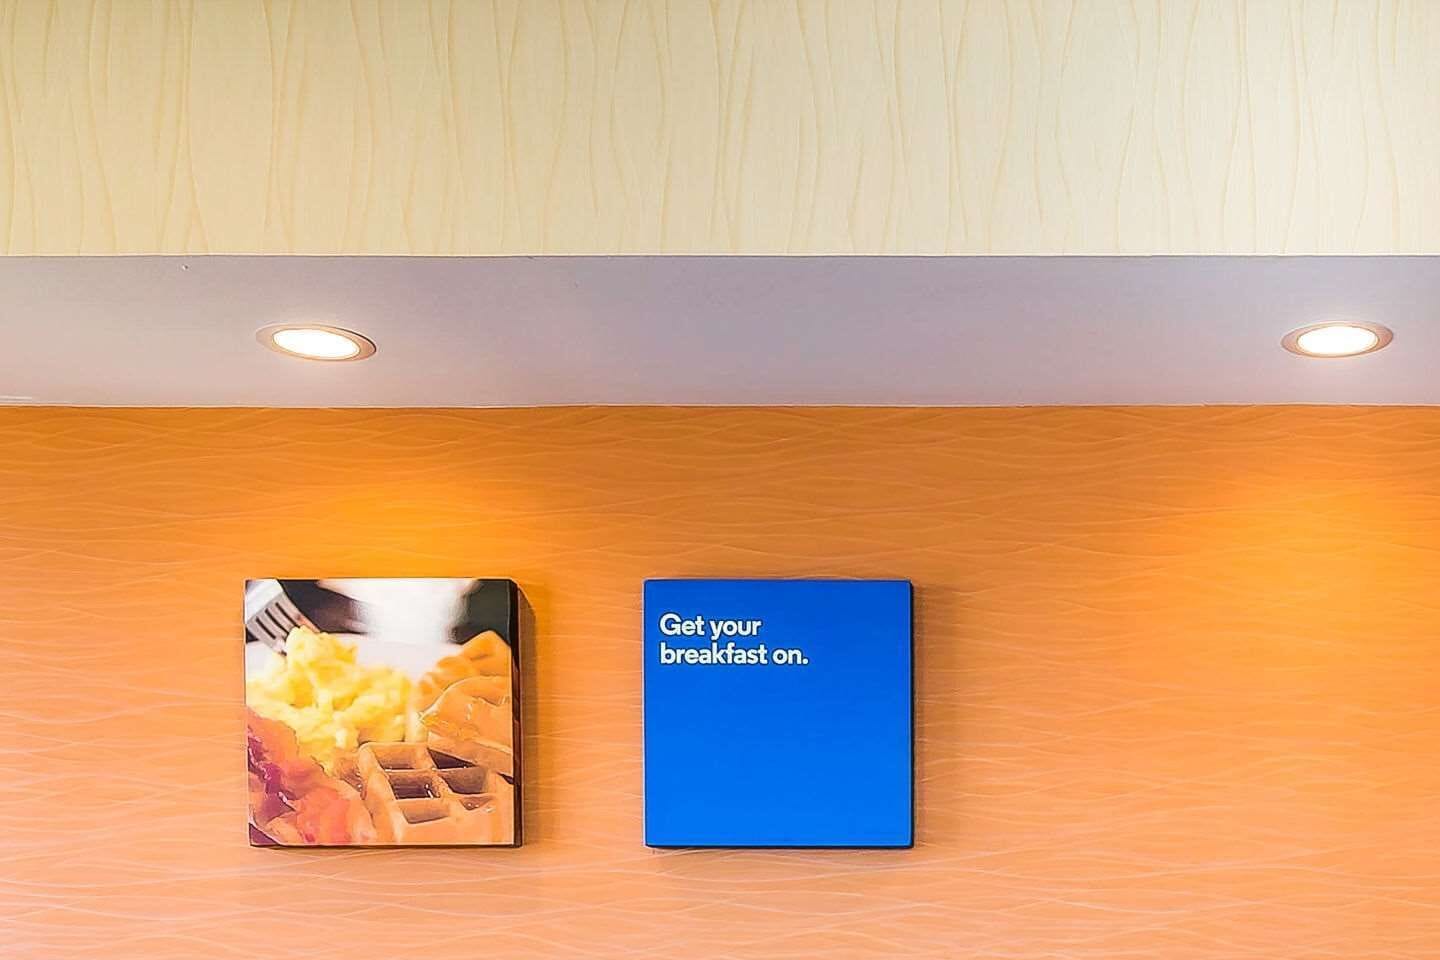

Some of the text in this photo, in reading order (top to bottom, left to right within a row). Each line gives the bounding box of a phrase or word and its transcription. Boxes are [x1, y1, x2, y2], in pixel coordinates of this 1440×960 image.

[659, 613, 762, 641] Get your
[660, 642, 809, 665] breakfast on.
